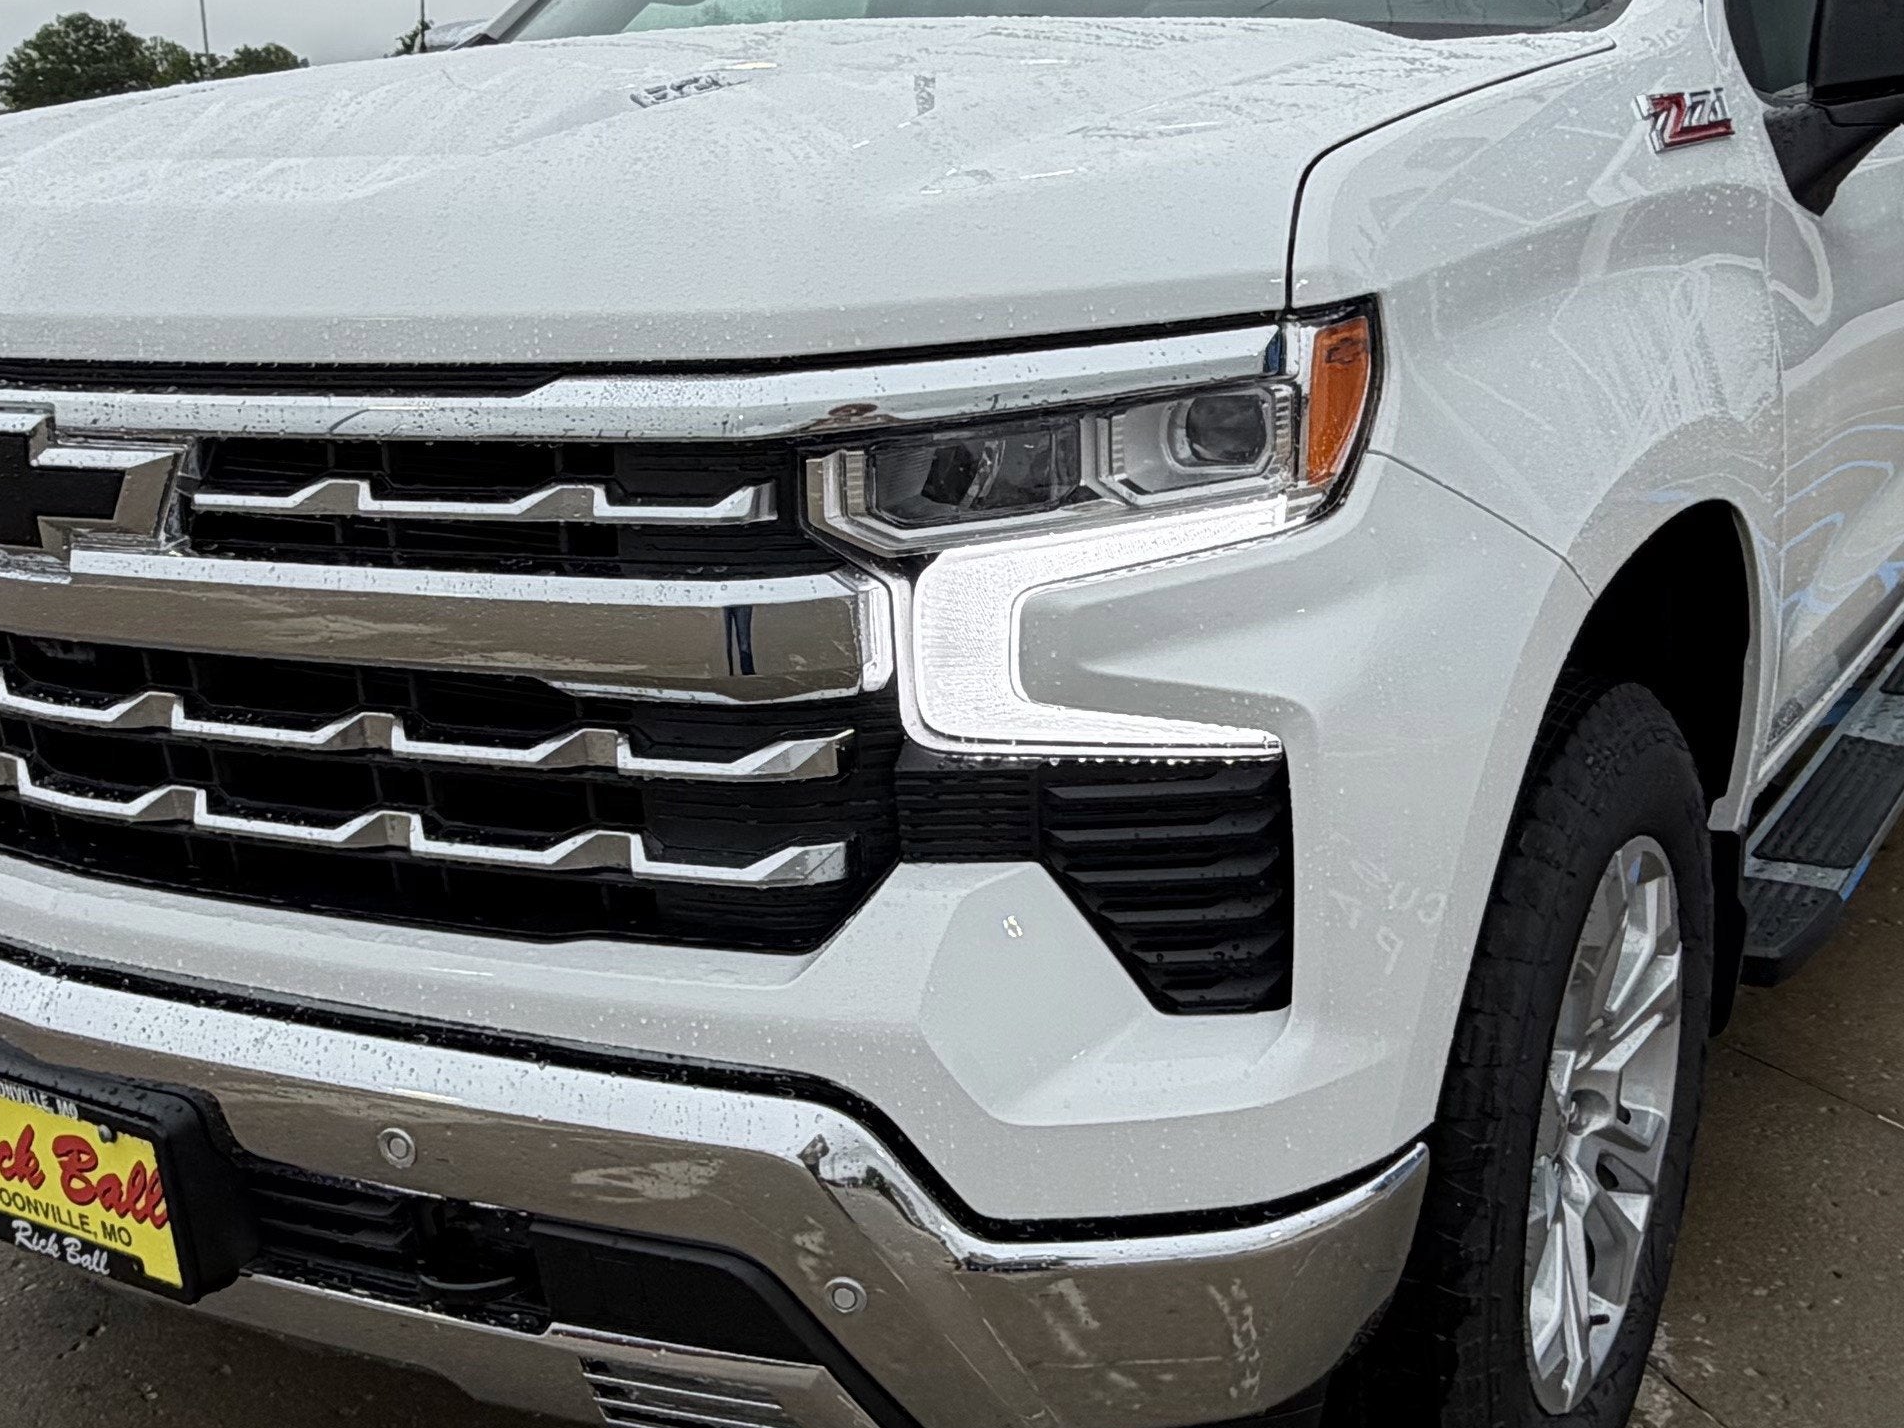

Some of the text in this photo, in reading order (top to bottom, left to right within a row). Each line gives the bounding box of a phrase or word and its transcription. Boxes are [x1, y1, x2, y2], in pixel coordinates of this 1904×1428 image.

[1632, 87, 1736, 153] Z71
[56, 1099, 78, 1120] MO
[52, 1134, 169, 1229] Ball
[12, 1220, 110, 1275] Rick Ball
[101, 1221, 132, 1247] MO
